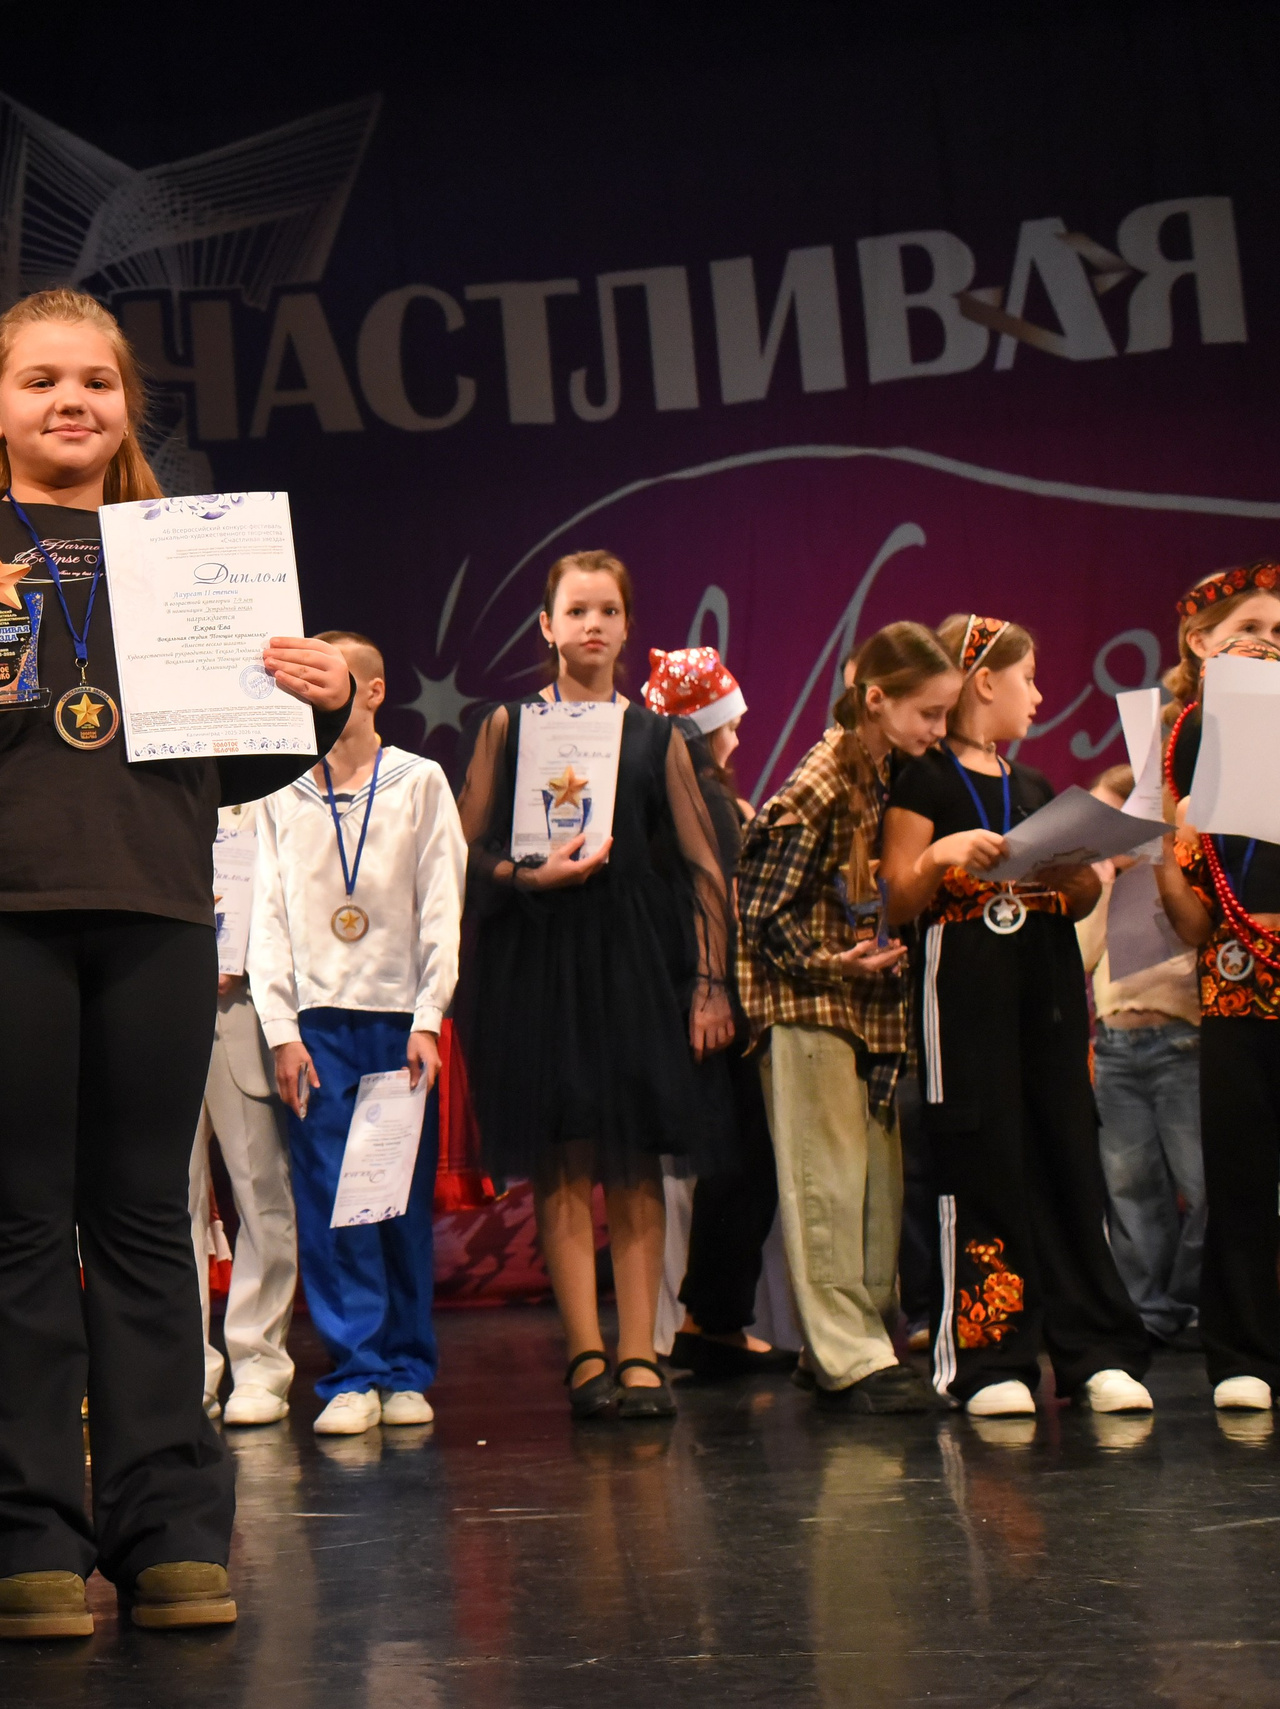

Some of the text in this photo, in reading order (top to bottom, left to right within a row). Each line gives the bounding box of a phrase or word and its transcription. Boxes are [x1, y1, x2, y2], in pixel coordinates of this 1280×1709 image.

[112, 193, 1248, 442] ЧАСТЛИВАЯ
[39, 538, 100, 551] Harmo
[192, 562, 287, 585] Диплом
[173, 591, 202, 600] Лауреат
[186, 613, 236, 623] награждается
[188, 633, 208, 641] студия
